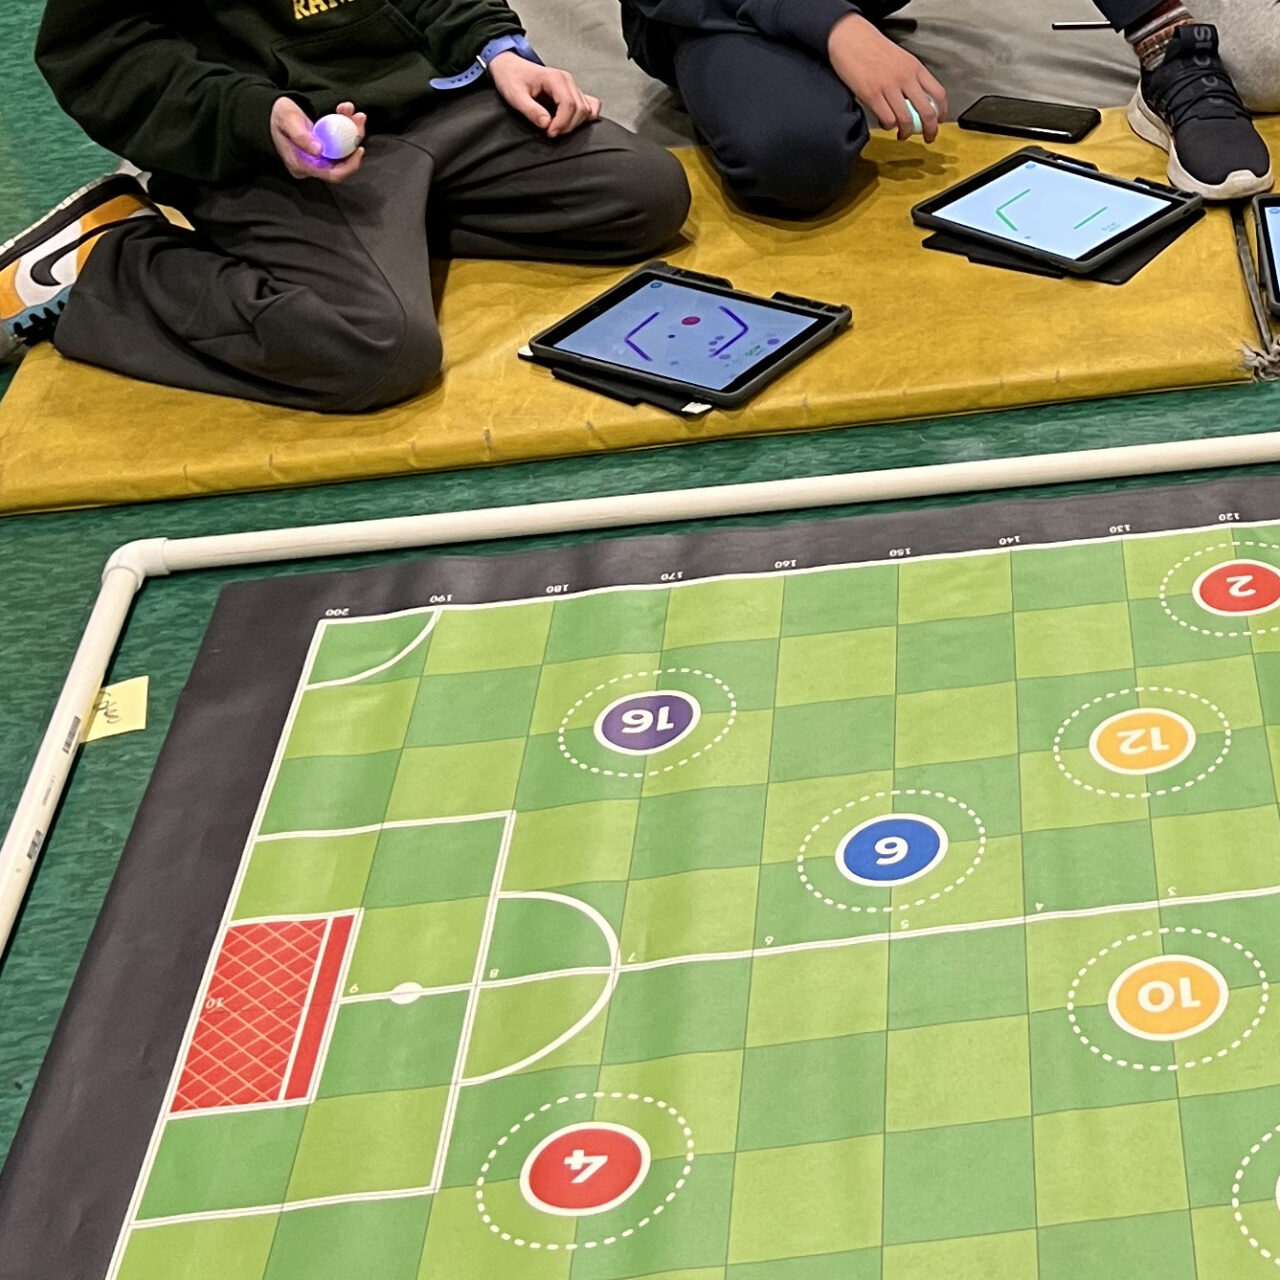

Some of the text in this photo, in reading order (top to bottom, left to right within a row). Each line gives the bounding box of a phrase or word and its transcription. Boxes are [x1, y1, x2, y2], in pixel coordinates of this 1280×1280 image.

[1218, 513, 1240, 521] 120
[1109, 524, 1130, 533] 130
[999, 535, 1020, 545] 140
[889, 548, 911, 557] 150
[774, 559, 797, 568] 160
[660, 571, 683, 581] 170
[546, 584, 569, 593] 180
[1226, 575, 1256, 597] 2
[429, 594, 453, 603] 190
[325, 608, 349, 616] 200
[621, 706, 674, 734] 16
[1118, 727, 1169, 755] 12
[1138, 977, 1200, 1013] 10
[564, 1150, 608, 1184] 4
